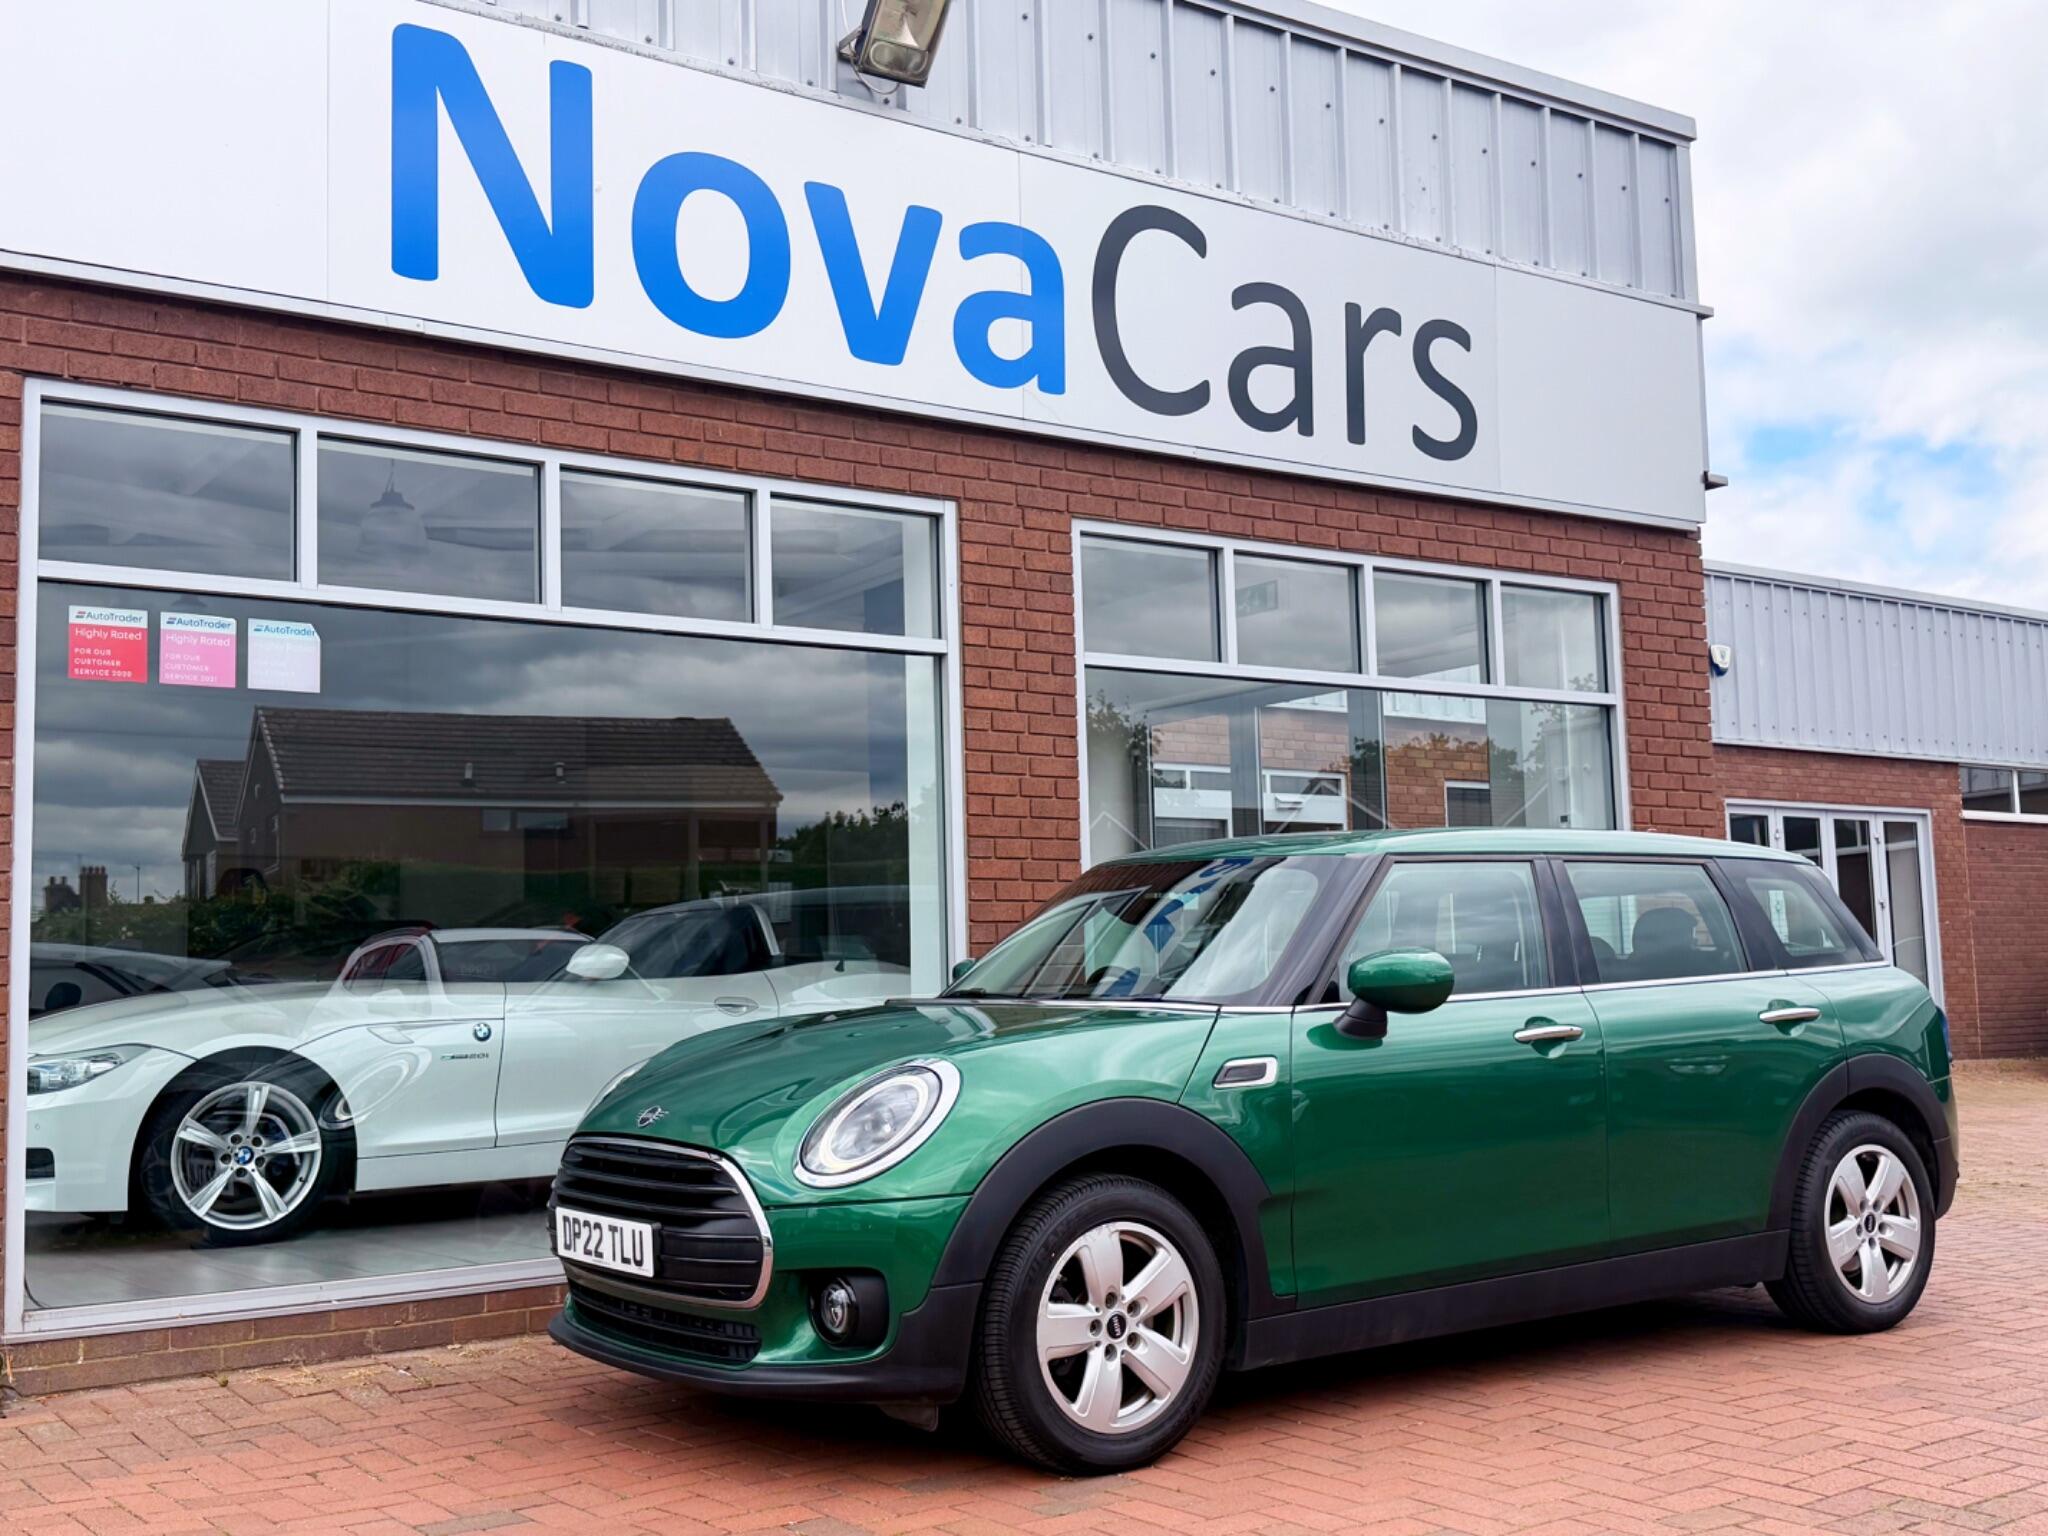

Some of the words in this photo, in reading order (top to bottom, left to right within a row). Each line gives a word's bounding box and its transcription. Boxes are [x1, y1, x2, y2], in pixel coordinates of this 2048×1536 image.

[391, 22, 1478, 461] NovaCars
[86, 611, 143, 623] AutoTrader
[176, 617, 232, 629] AutoTrader
[75, 627, 109, 639] Highly
[111, 630, 142, 640] Rated
[166, 633, 198, 646] Highly
[200, 636, 231, 647] Rated
[93, 648, 112, 656] OUR
[74, 658, 121, 667] CUSTOMER
[165, 663, 209, 672] CUSTOMER
[74, 668, 110, 677] SERVICE
[562, 1215, 604, 1259] DP22
[607, 1224, 645, 1268] TLU
